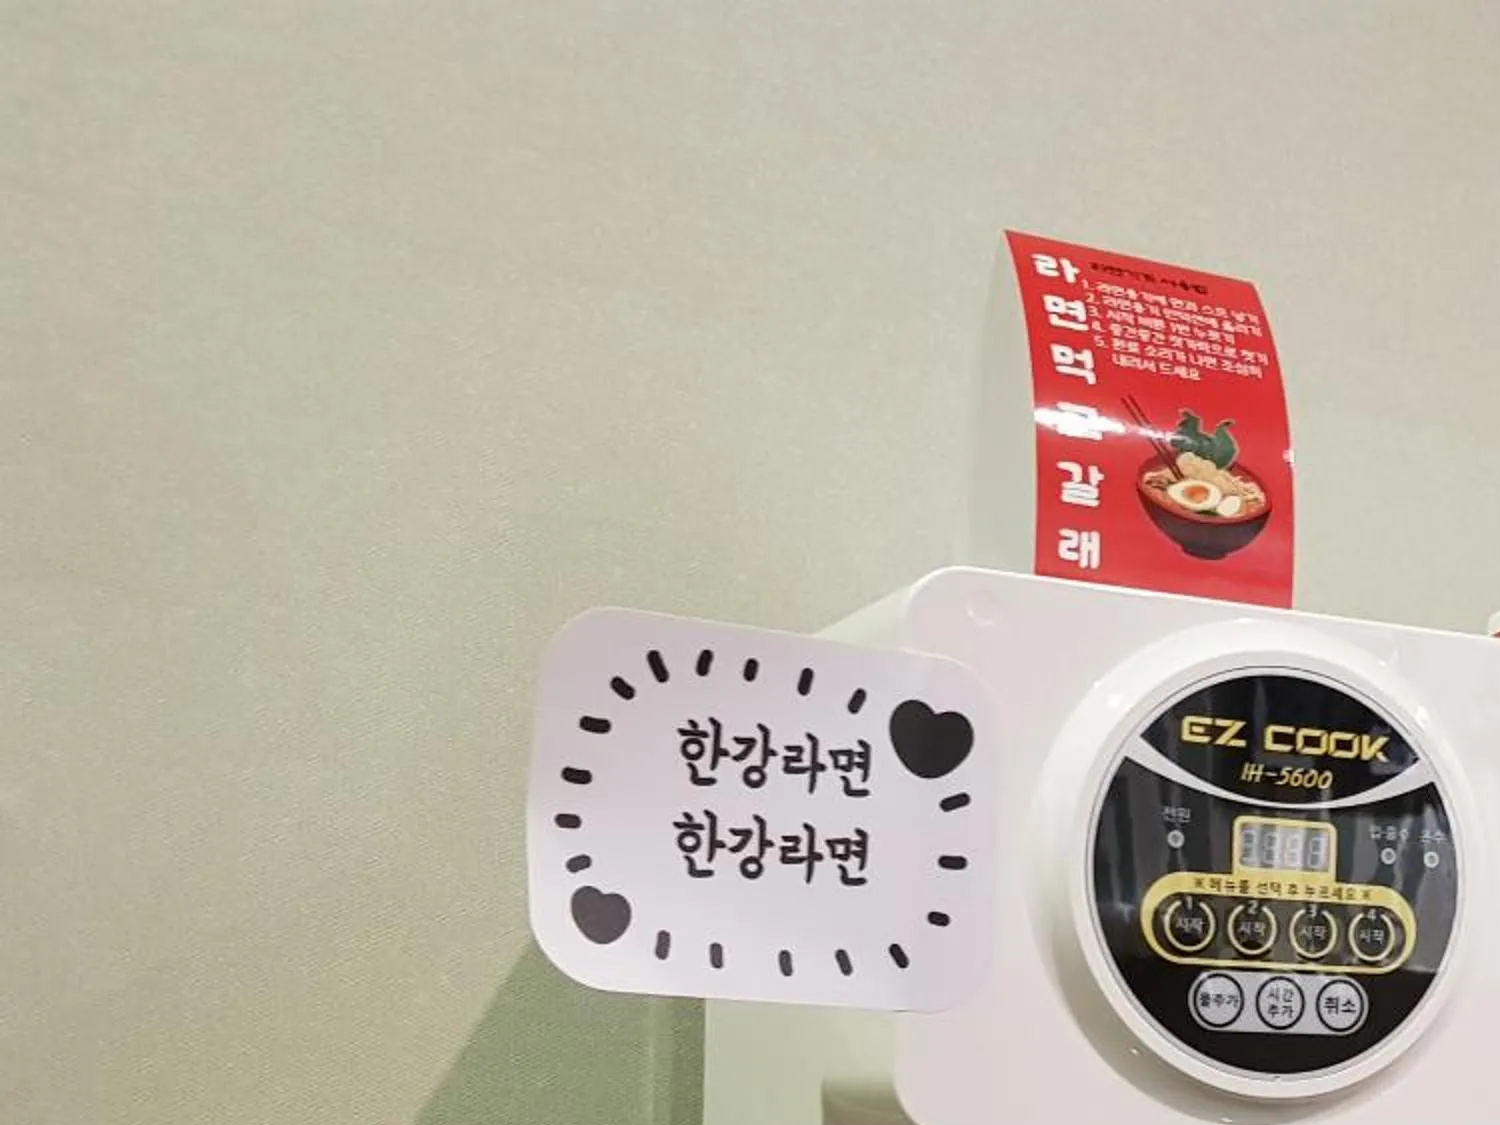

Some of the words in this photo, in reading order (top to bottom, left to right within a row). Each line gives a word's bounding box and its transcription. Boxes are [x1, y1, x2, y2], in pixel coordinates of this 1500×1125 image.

[1181, 715, 1247, 748] EZ
[1264, 724, 1391, 763] COOK
[676, 717, 872, 797] 한강라면
[1240, 762, 1333, 790] IH-5600
[673, 809, 869, 887] 한강라면
[1248, 900, 1258, 914] 2
[1268, 987, 1295, 1004] 시간
[1324, 997, 1357, 1015] 취소
